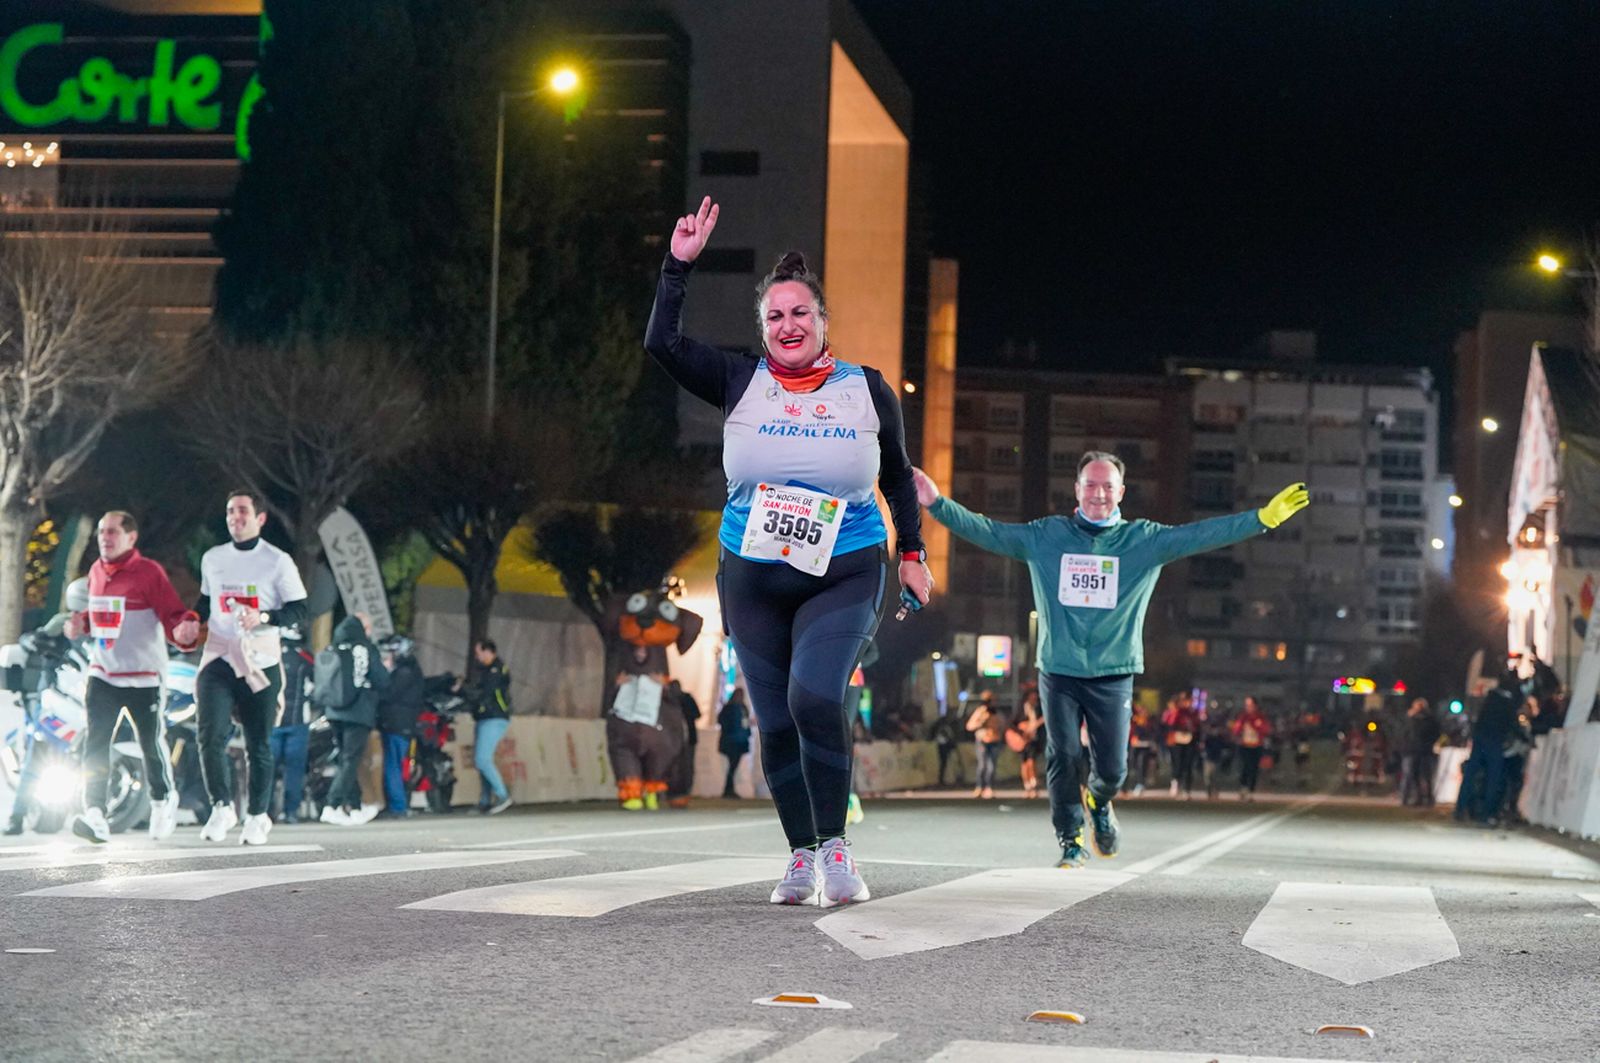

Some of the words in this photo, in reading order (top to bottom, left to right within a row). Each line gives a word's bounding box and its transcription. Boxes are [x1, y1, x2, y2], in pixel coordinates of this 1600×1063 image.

[0, 23, 221, 130] Corte
[758, 424, 857, 440] MARACENA
[763, 500, 780, 509] SAN
[776, 493, 801, 504] NOCHE
[802, 497, 814, 507] DE
[763, 510, 824, 546] 3595
[345, 531, 388, 636] APEMASA
[1071, 573, 1106, 590] 5951
